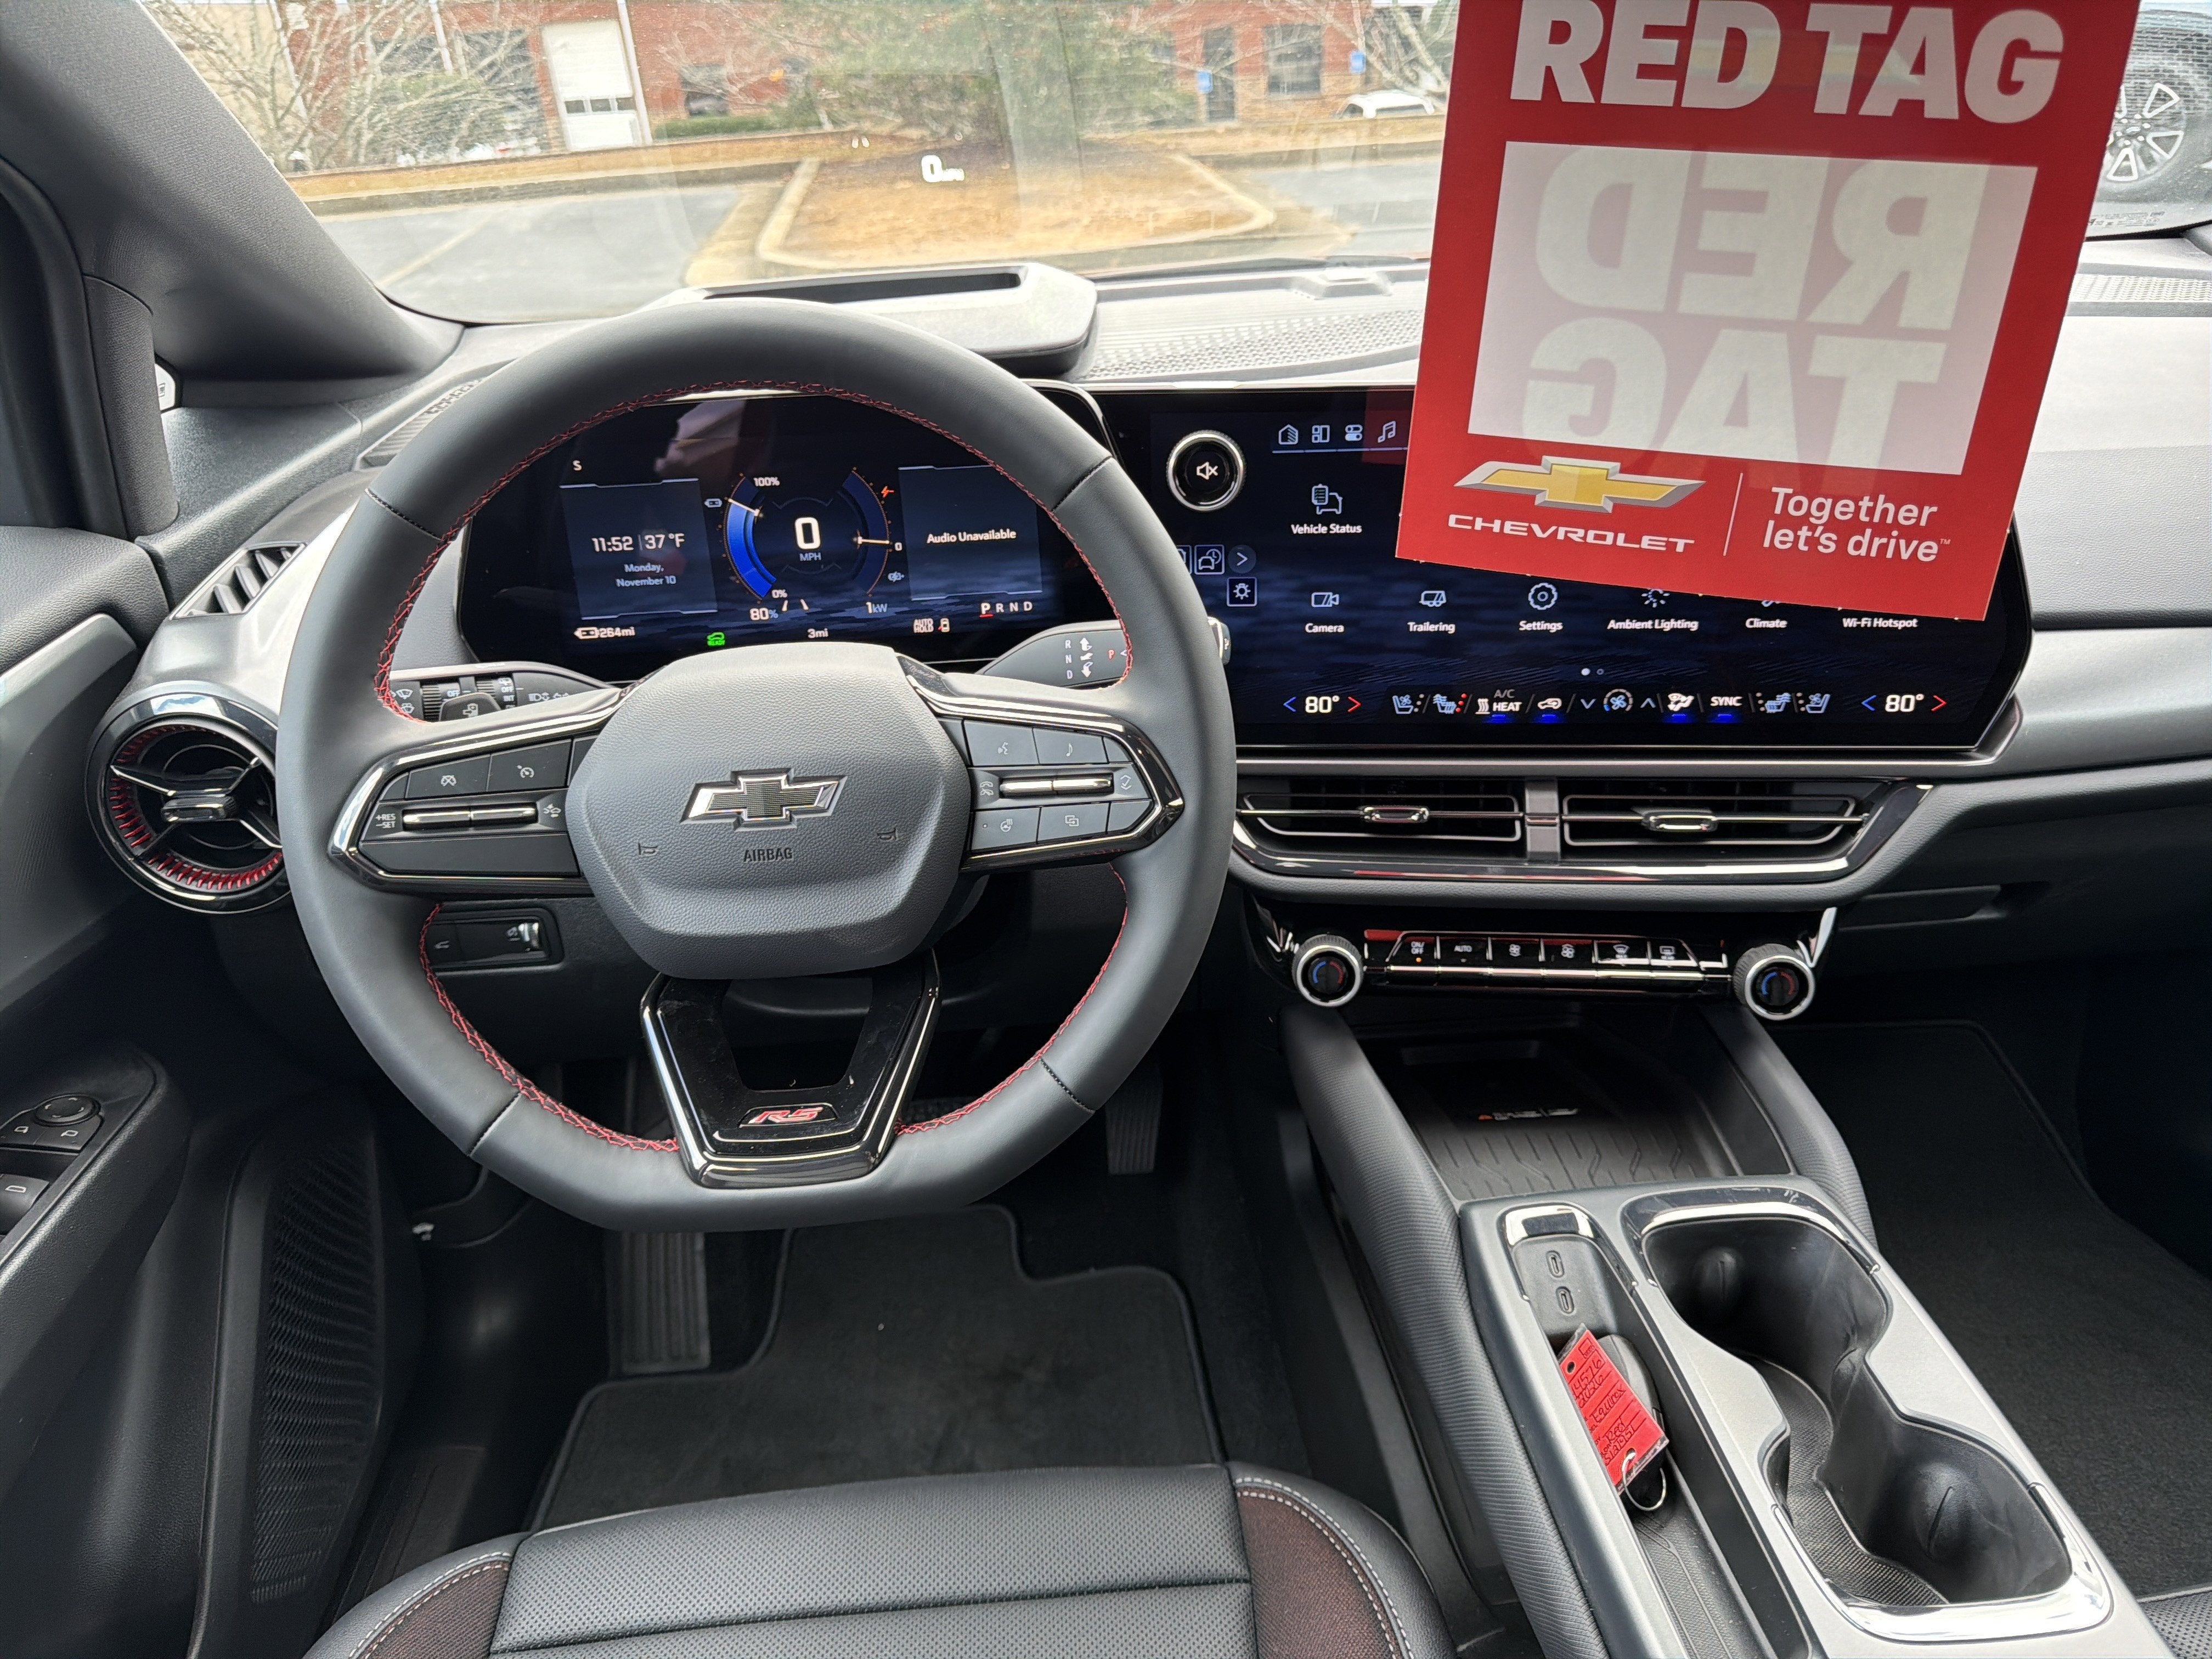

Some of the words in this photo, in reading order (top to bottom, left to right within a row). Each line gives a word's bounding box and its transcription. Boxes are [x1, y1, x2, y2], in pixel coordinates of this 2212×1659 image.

[1509, 0, 1781, 110] RED
[1805, 4, 2064, 123] TAG
[572, 460, 582, 471] S
[753, 477, 780, 487] 100%
[1771, 487, 1938, 526] Together
[795, 517, 821, 549] 0
[1291, 523, 1327, 534] Vehicle
[1329, 523, 1362, 533] Status
[1448, 514, 1695, 552] CHEVROLET
[927, 532, 957, 544] Audio
[958, 528, 1017, 541] Unavailable
[1763, 520, 1838, 553] let's
[591, 536, 634, 552] 11:52
[644, 534, 665, 549] 37
[894, 542, 902, 551] 0
[799, 552, 822, 561] MPH
[616, 577, 663, 587] November
[664, 575, 676, 584] 10
[771, 589, 788, 599] 0%
[981, 602, 991, 614] P
[996, 603, 1005, 613] R
[1009, 602, 1018, 612] N
[1024, 601, 1032, 611] D
[749, 608, 778, 620] 80%
[914, 624, 934, 633] HOLD
[1305, 623, 1344, 633] Camera
[1408, 621, 1455, 634] Trailering
[1519, 620, 1563, 633] Settings
[1607, 619, 1653, 630] Ambient
[1654, 618, 1699, 631] Lighting
[1745, 618, 1787, 628] Climate
[1842, 618, 1872, 628] Wi-Fi
[1873, 618, 1918, 630] Hotspot
[599, 627, 635, 638] 264mi
[807, 628, 828, 639] 3mi
[1065, 640, 1071, 649] R
[1065, 654, 1072, 664] N
[1107, 649, 1115, 659] P
[1066, 670, 1073, 680] D
[1494, 689, 1515, 698] A/C
[1710, 696, 1742, 706] SYNC
[1492, 702, 1522, 712] HEAT
[743, 848, 793, 862] AIRBAG
[748, 1107, 823, 1124] RS
